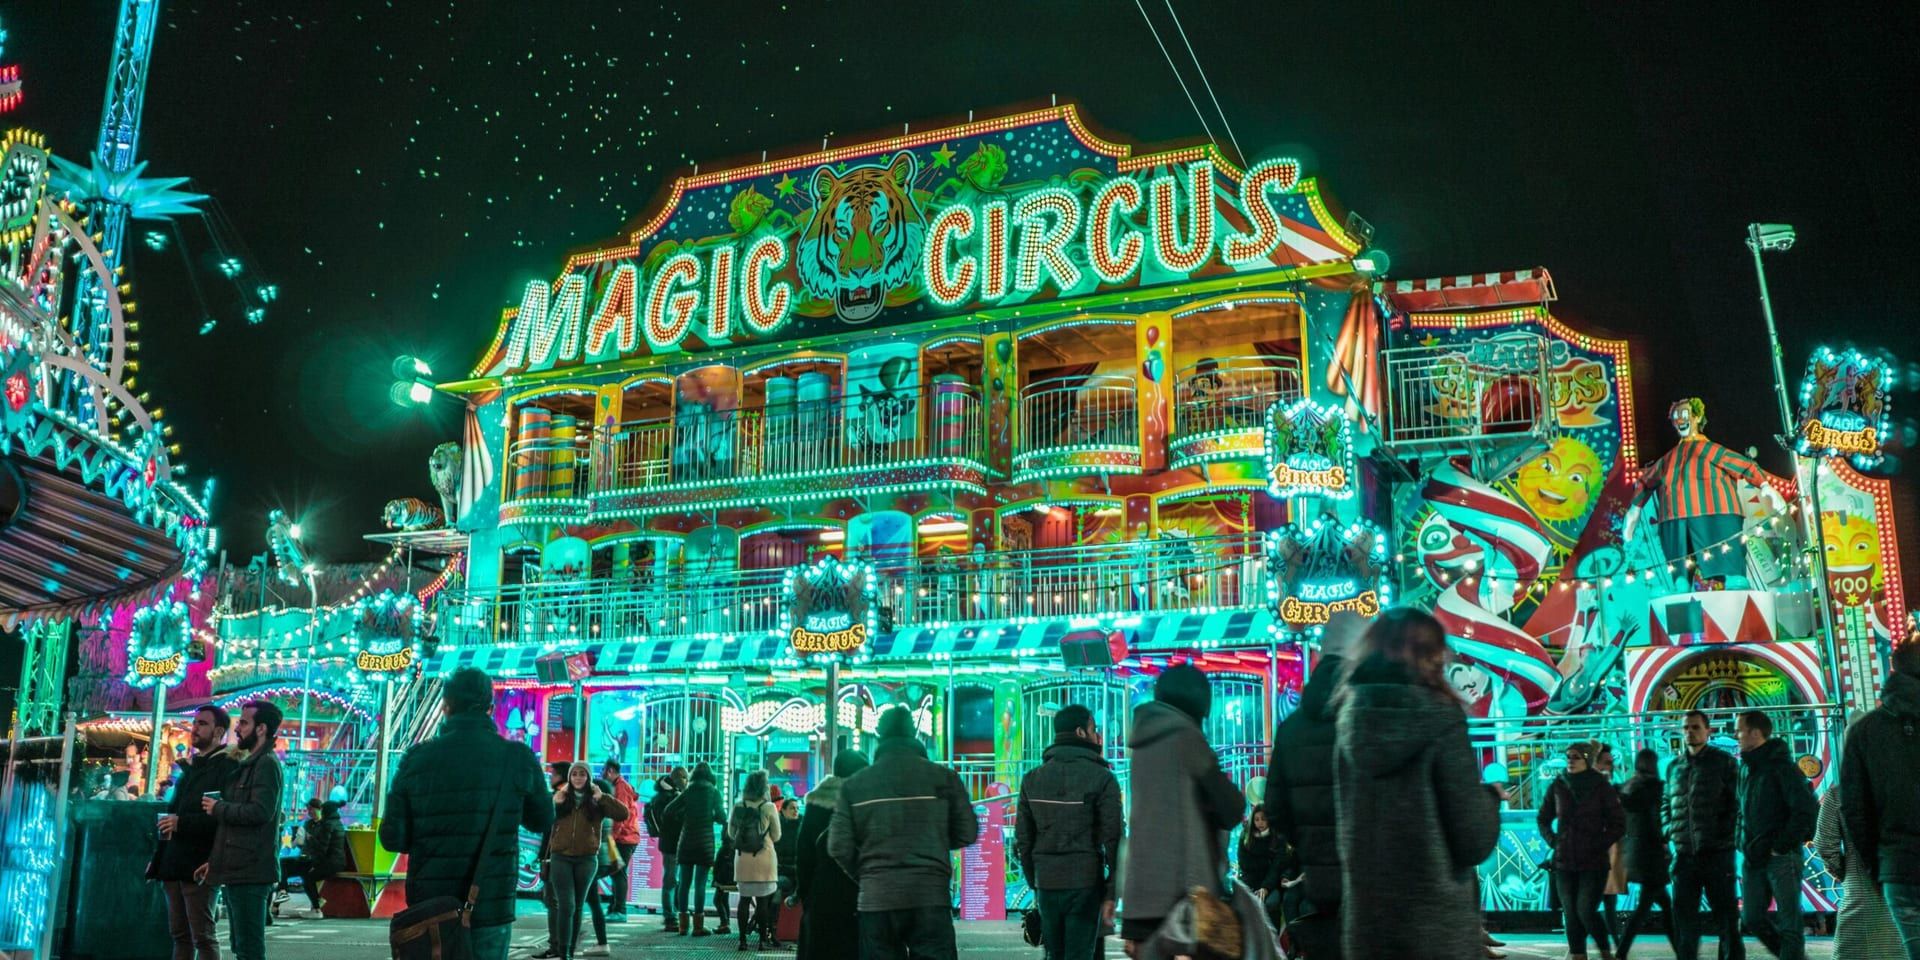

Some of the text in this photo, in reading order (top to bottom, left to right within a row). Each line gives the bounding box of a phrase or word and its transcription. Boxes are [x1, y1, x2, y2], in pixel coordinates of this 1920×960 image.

[505, 157, 1301, 368] MAGIC CIRCUS
[1821, 411, 1866, 431] MAGIC
[1806, 420, 1876, 455] CIRCUS
[1289, 457, 1332, 470] MAGIC
[1273, 463, 1345, 488] CIRCUS
[1300, 581, 1356, 599] MAGIC
[1833, 576, 1868, 593] 100
[805, 614, 850, 630] MAGIC
[791, 624, 866, 652] CIRCUS
[135, 652, 181, 675] CIRCUS
[357, 648, 411, 671] CIRCUS
